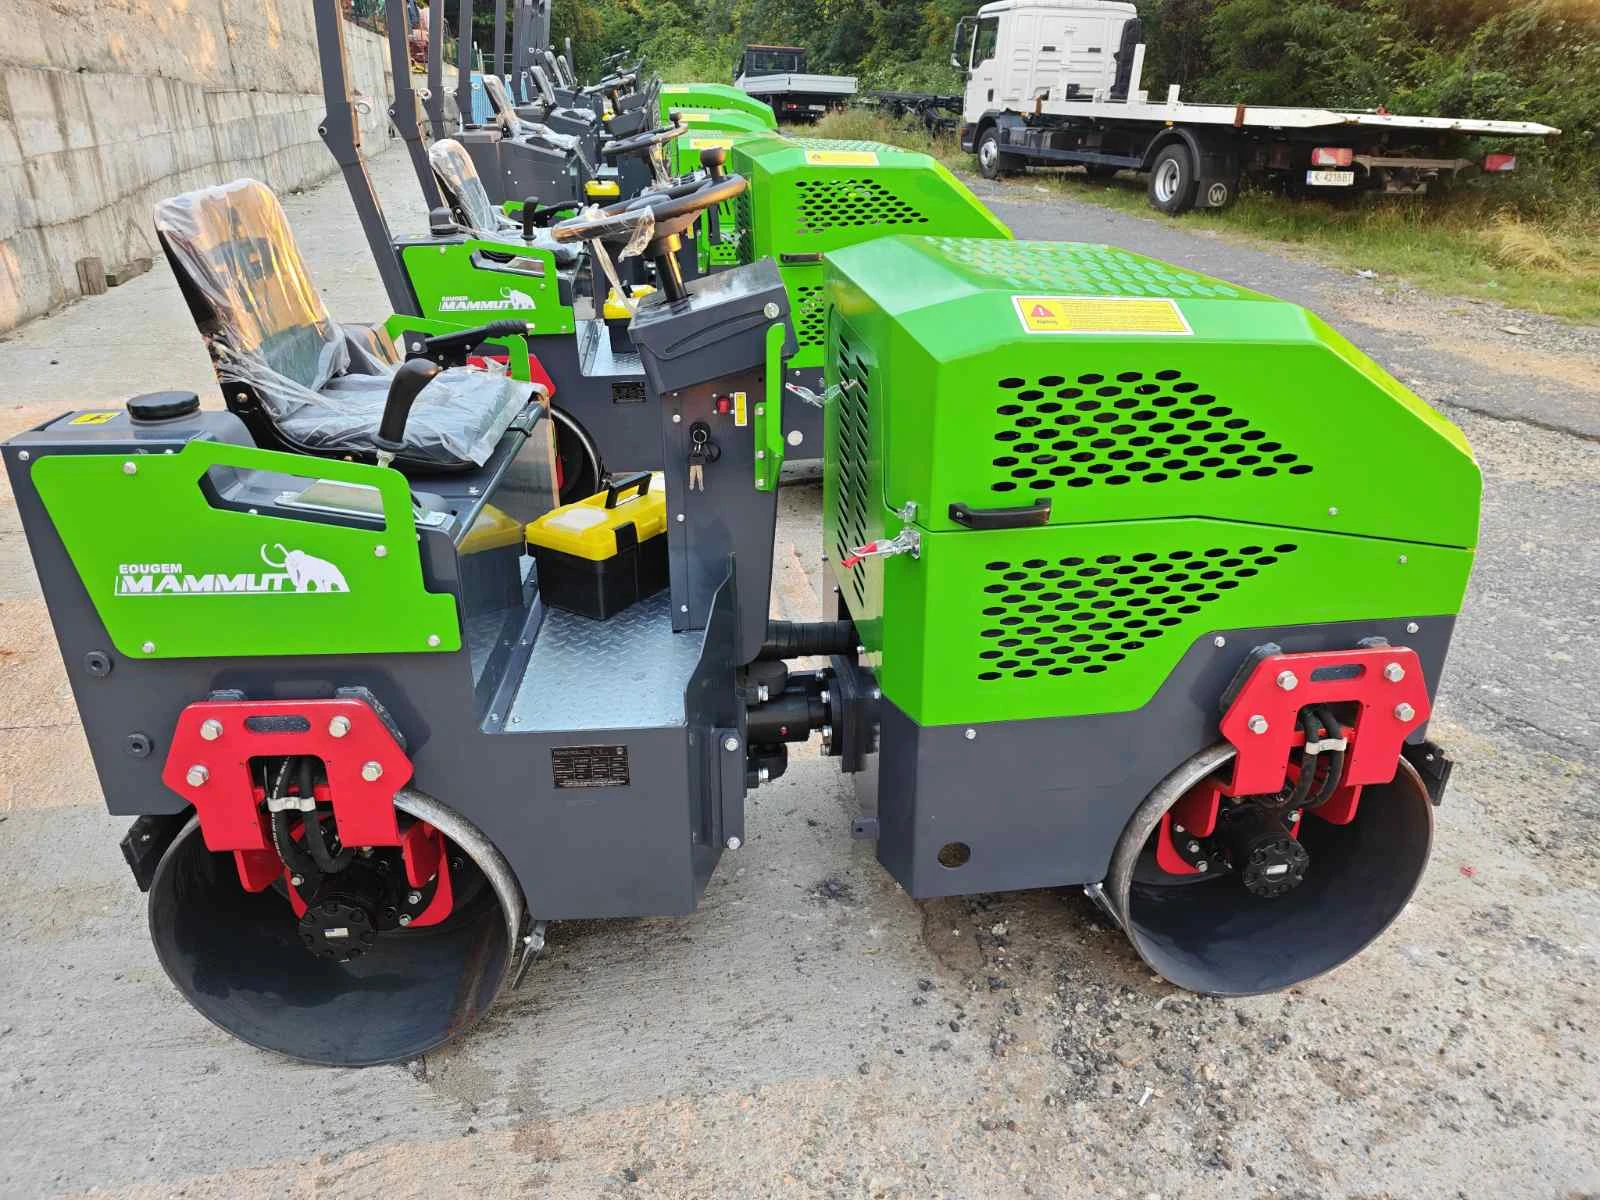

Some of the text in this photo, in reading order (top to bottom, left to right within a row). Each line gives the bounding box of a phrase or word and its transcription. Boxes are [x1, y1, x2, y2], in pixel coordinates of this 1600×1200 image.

[441, 301, 510, 310] MAMMUT
[119, 563, 183, 574] EOUGEM
[120, 574, 289, 593] MAMMUT
